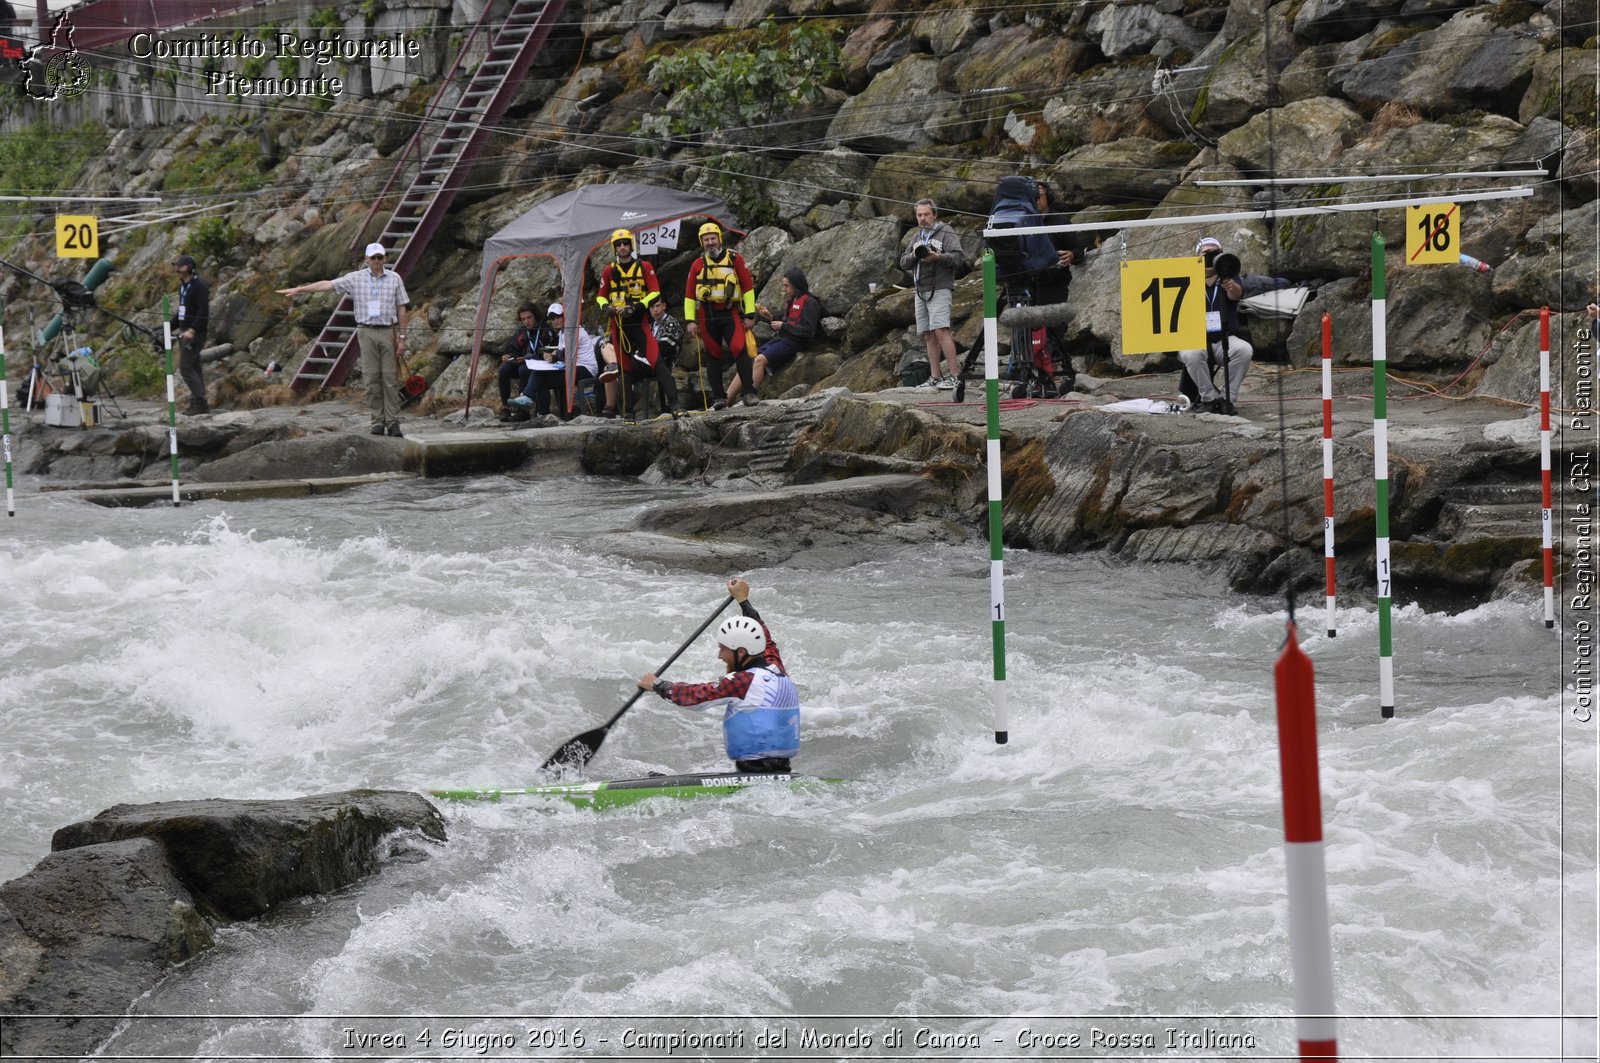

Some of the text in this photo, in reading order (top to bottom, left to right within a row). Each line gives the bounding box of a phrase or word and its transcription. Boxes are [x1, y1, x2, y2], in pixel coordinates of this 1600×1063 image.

[64, 223, 92, 249] 20
[641, 232, 657, 245] 23
[660, 226, 676, 240] 24
[1418, 213, 1450, 252] 18
[1141, 276, 1191, 335] 17
[994, 602, 1001, 620] 1
